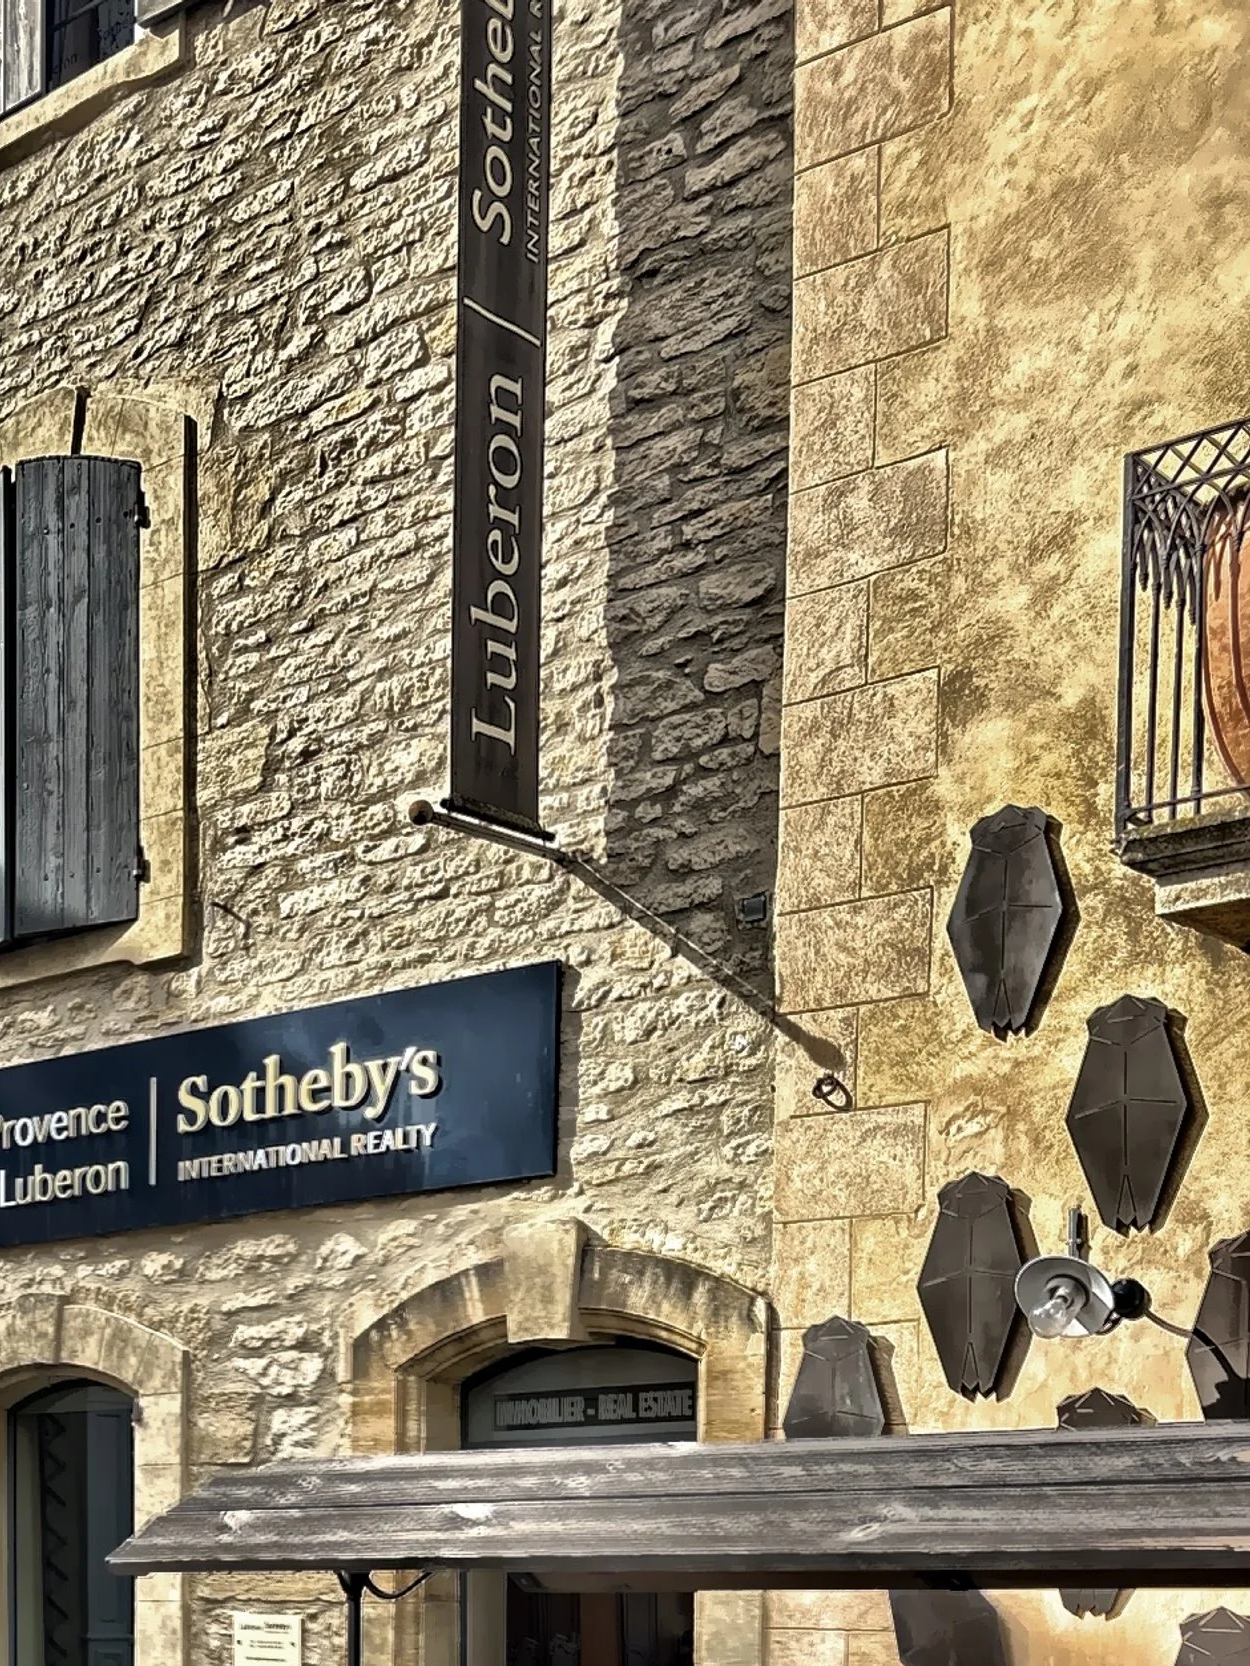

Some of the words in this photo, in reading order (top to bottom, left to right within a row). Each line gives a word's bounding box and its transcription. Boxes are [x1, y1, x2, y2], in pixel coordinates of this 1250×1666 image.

[526, 29, 543, 265] INTERNATIONAL
[469, 372, 523, 756] Luberon
[176, 1041, 440, 1134] Sotheby's
[177, 1137, 348, 1182] INTERNATIONAL
[351, 1122, 438, 1156] REALTY
[496, 1395, 586, 1426] IMMOBILIER
[598, 1391, 637, 1421] REAL
[639, 1389, 694, 1418] ESTATE
